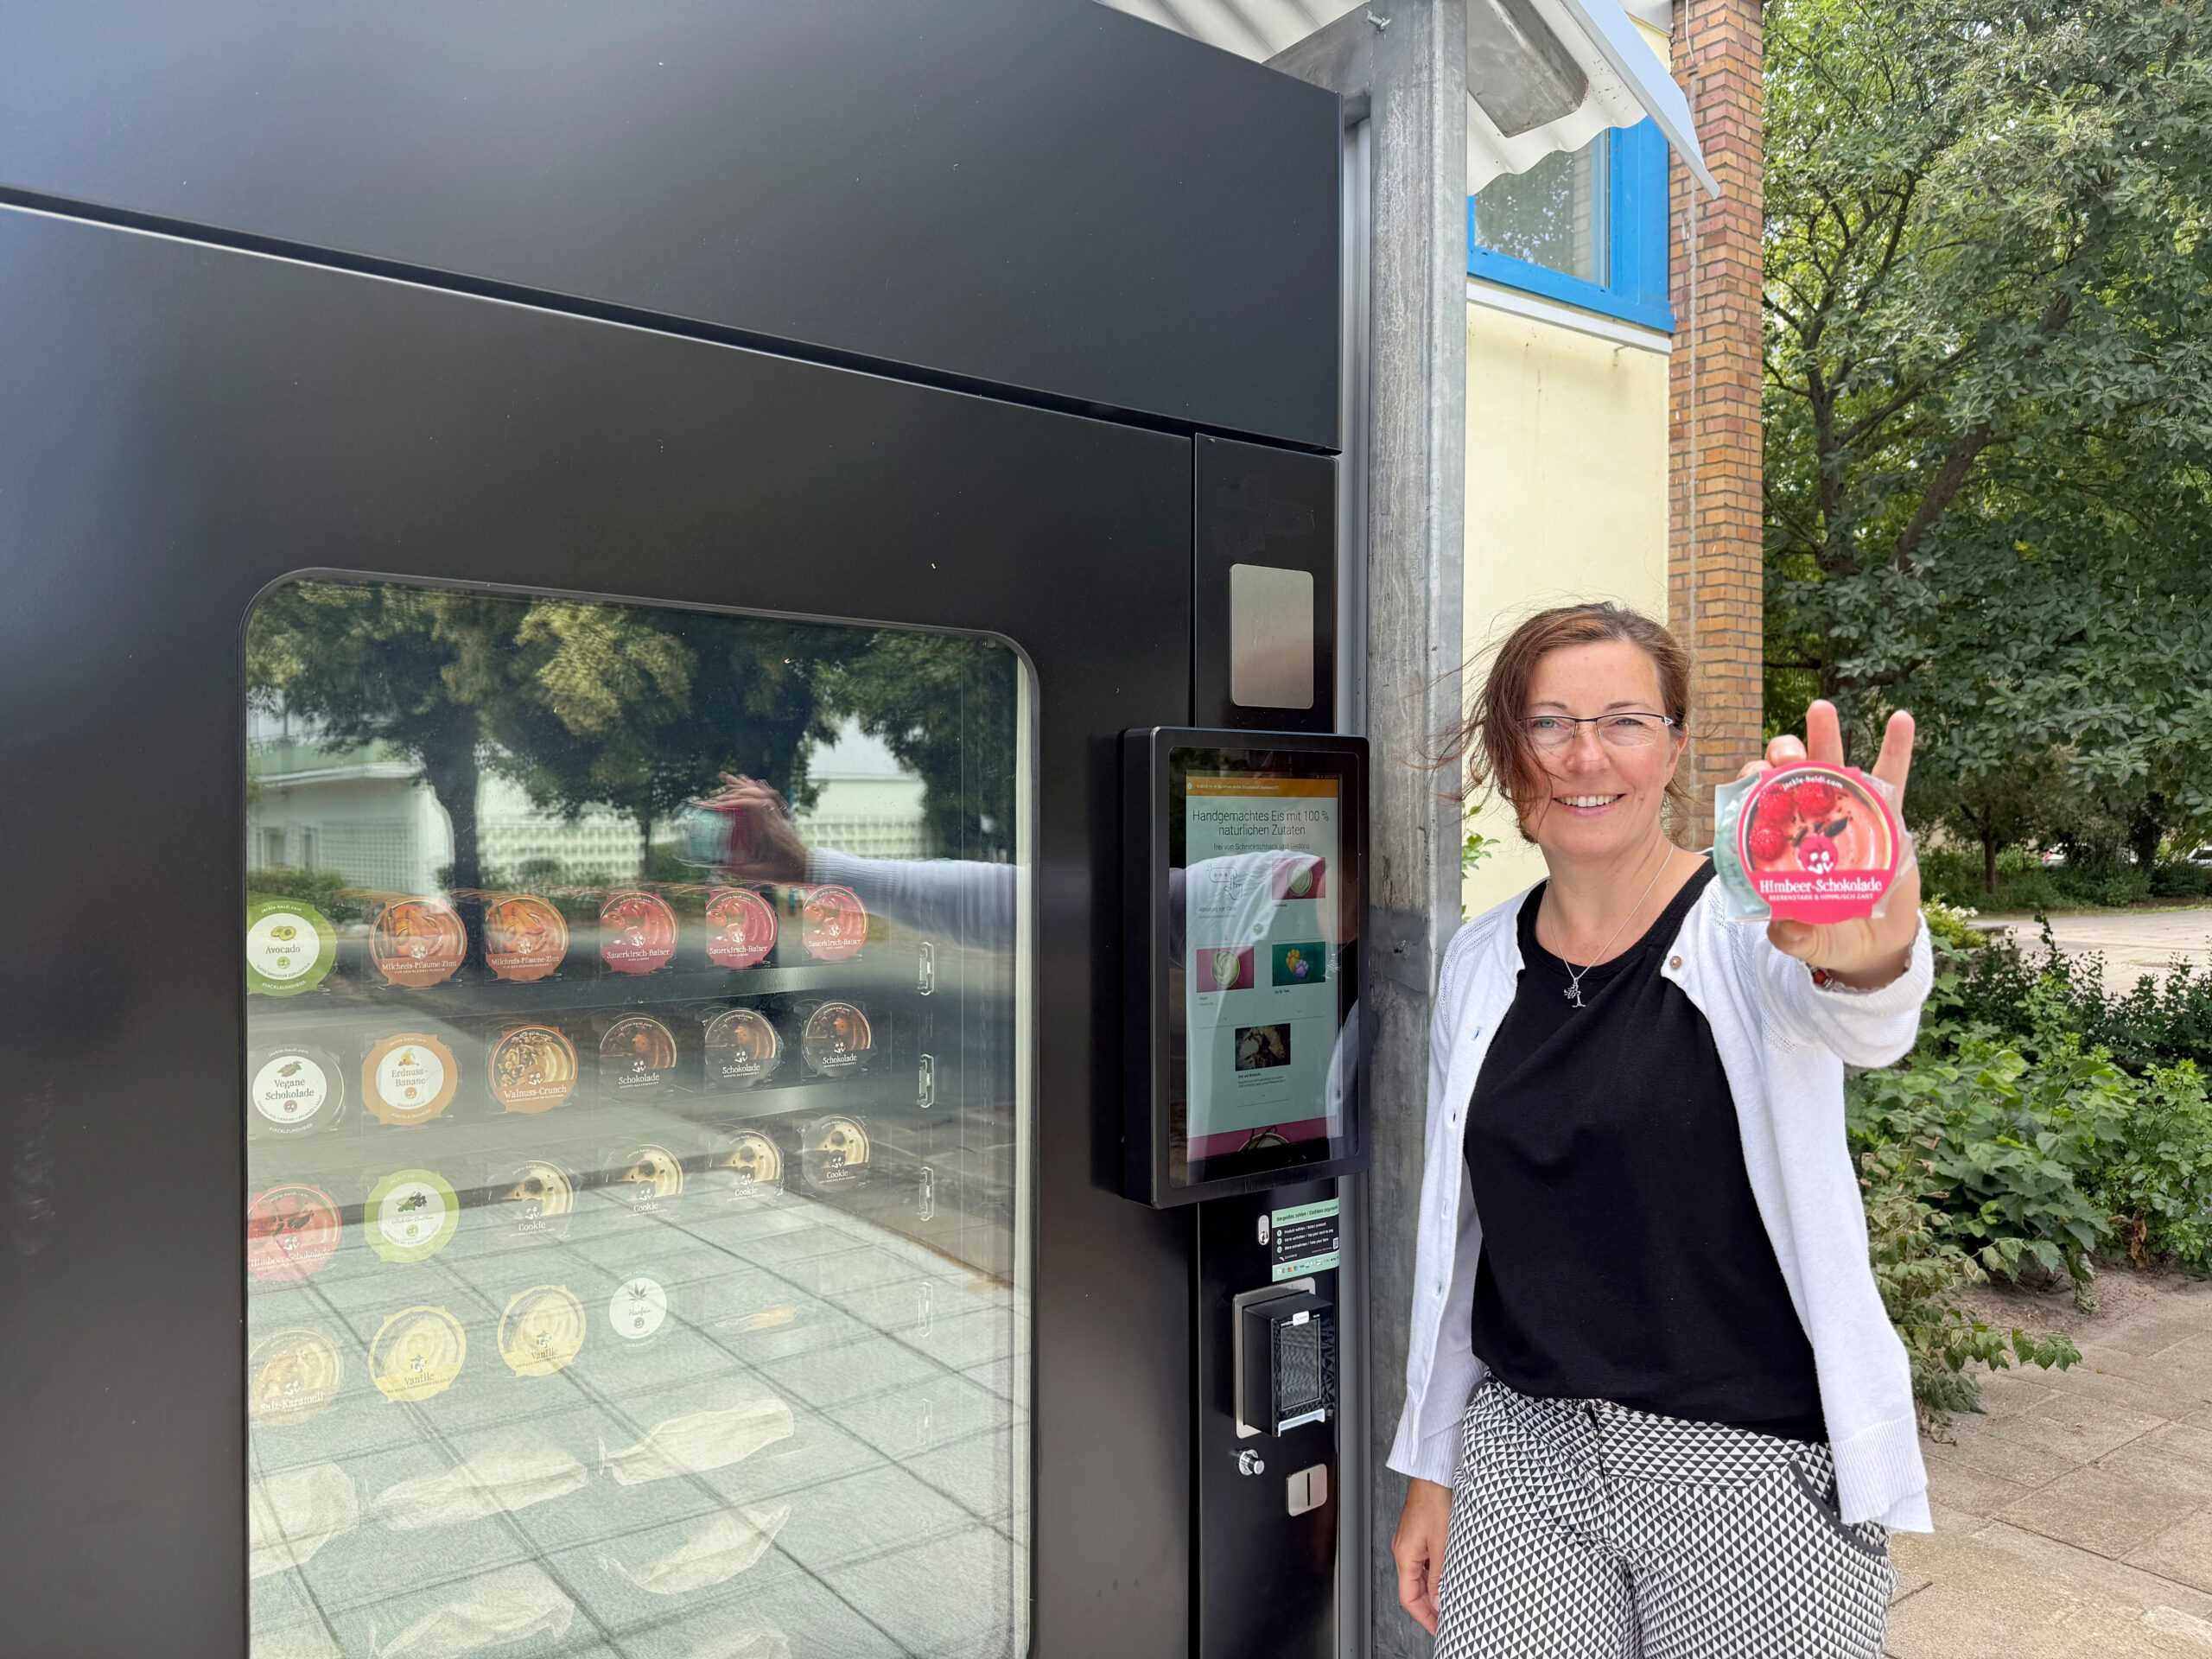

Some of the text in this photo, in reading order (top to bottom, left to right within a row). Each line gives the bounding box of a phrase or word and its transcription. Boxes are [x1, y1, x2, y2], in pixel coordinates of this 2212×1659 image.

[1783, 774, 1844, 791] jackie-heidi.com
[1192, 810, 1268, 823] Handgemachtes
[1272, 810, 1285, 823] Eis
[1287, 810, 1301, 822] mit
[1304, 810, 1319, 822] 100
[1272, 824, 1306, 836] Zutaten
[1759, 877, 1882, 893] Himbeer-Schokolade
[265, 944, 301, 954] Avocado
[823, 1053, 858, 1065] Schokolade
[721, 1063, 760, 1075] Schokolade
[273, 1078, 306, 1089] Vegane
[618, 1072, 660, 1085] Schokolade
[264, 1088, 315, 1100] Schokolade
[826, 1168, 849, 1179] Cookie
[633, 1203, 658, 1211] Cookie
[518, 1220, 546, 1231] Cookie
